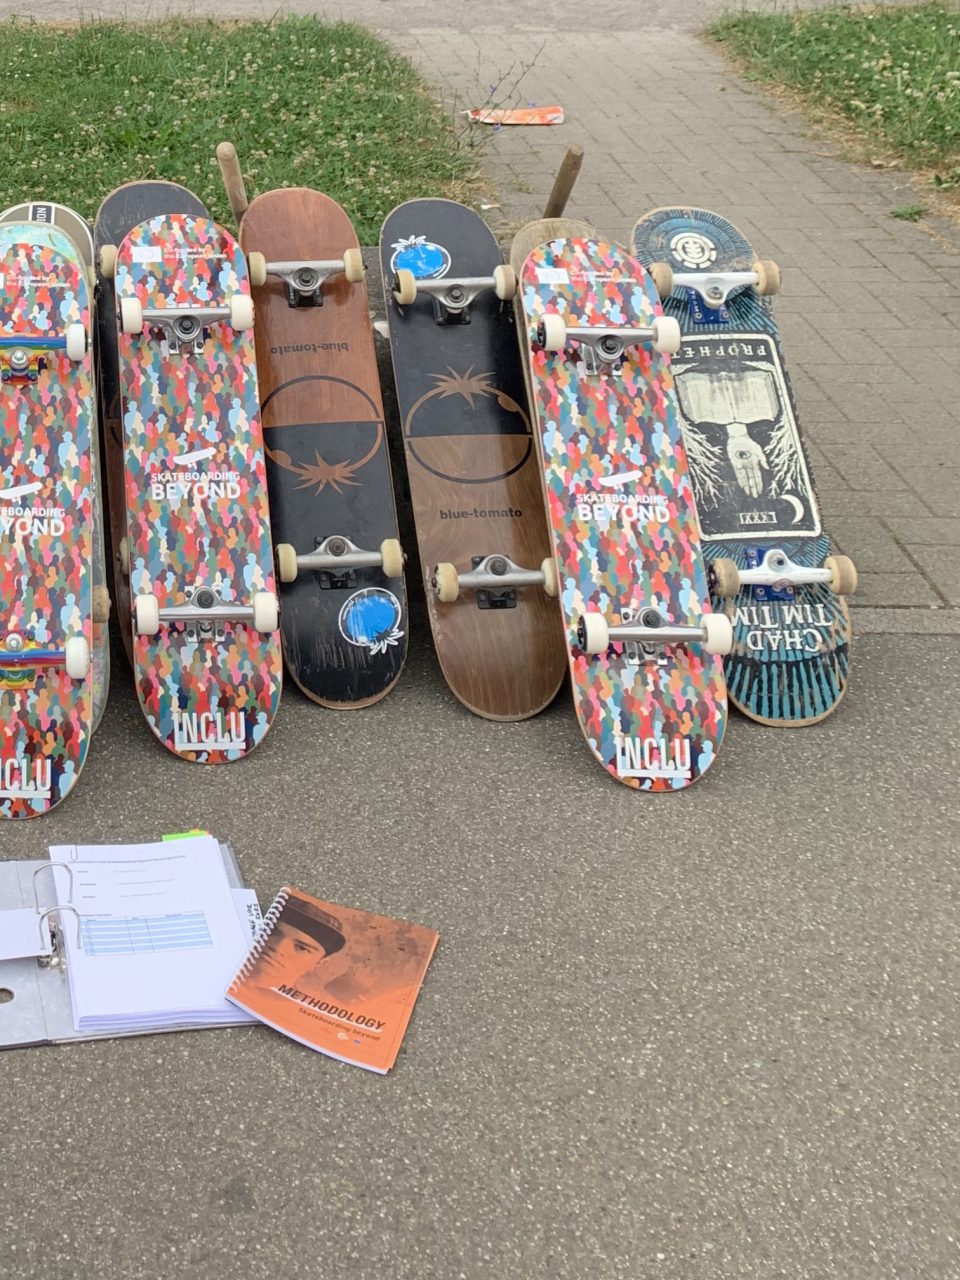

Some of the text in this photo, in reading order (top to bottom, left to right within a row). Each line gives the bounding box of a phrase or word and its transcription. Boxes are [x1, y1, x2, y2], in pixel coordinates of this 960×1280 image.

[270, 341, 349, 354] blue-tomato
[671, 343, 767, 358] PROPHET
[151, 471, 241, 483] SKATEBOARDING
[151, 482, 241, 500] BEYOND
[575, 493, 669, 505] SKATEBOARDING
[439, 507, 523, 520] blue-tomato
[578, 503, 671, 523] BEYOND
[731, 603, 833, 629] TIM TIM
[746, 627, 823, 653] CHAD
[173, 711, 247, 747] INCLU
[615, 737, 692, 774] INCLU
[278, 984, 386, 1030] METHODOLOGY
[299, 1007, 382, 1041] Skateboarding beyond
